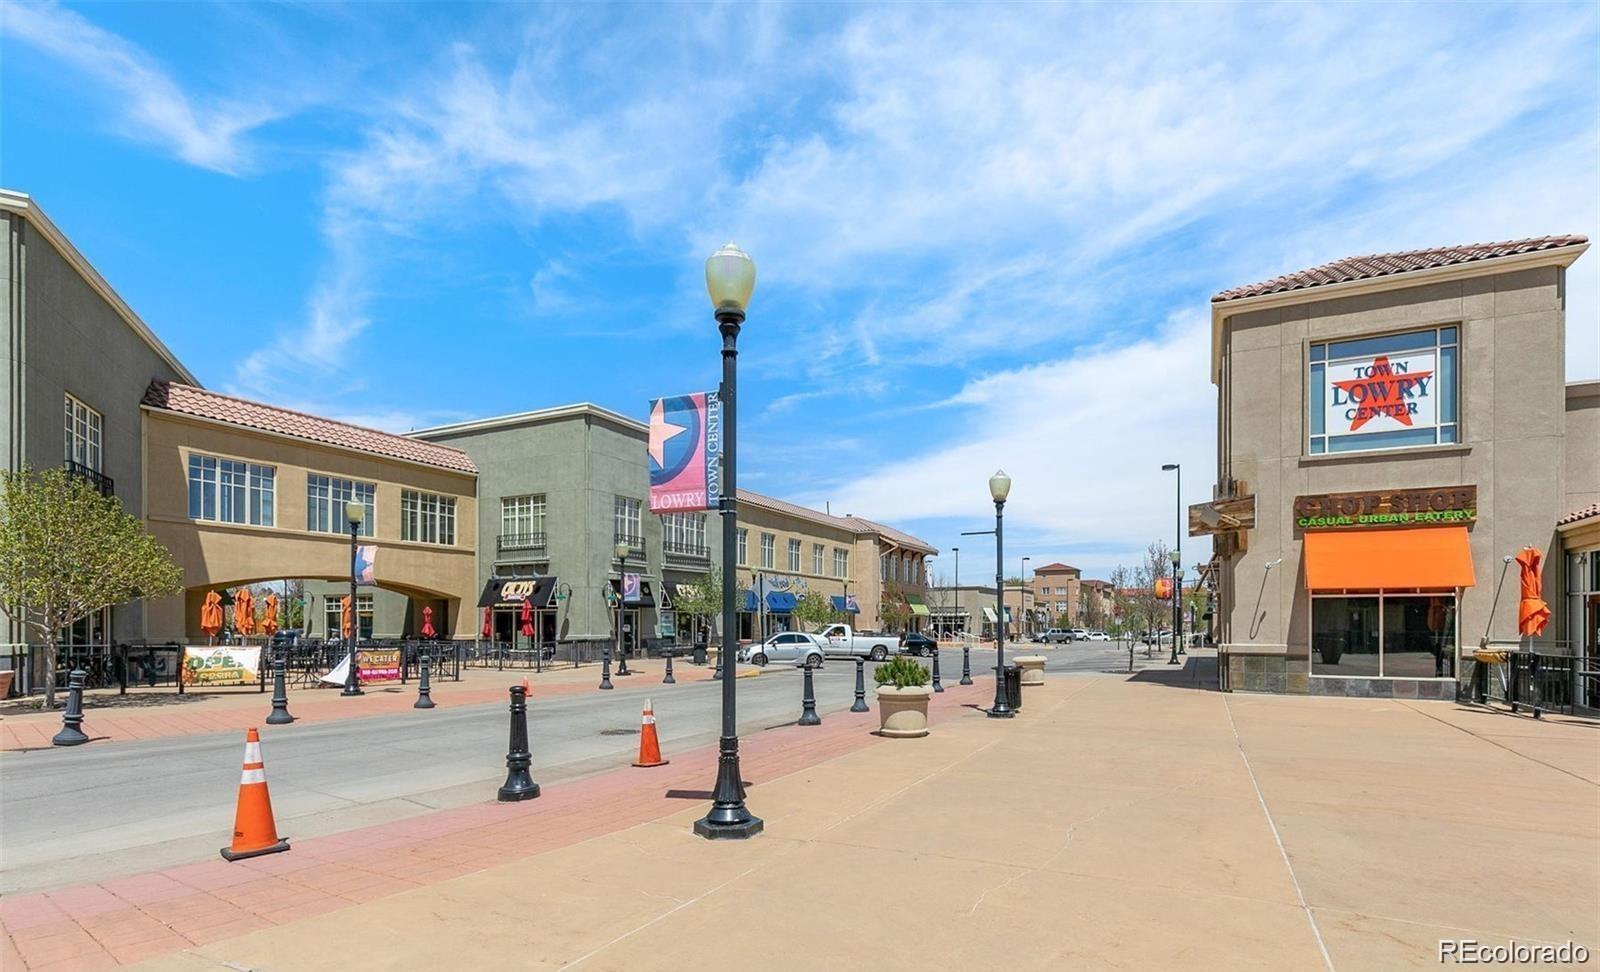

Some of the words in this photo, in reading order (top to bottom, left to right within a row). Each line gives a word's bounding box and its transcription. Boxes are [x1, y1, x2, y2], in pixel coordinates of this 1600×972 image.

[1353, 361, 1408, 379] TOWN
[1331, 375, 1432, 407] LOWRY
[707, 391, 720, 453] CENTER
[1344, 402, 1419, 421] CENTER
[707, 456, 719, 505] TOWN
[650, 491, 705, 510] LOWRY
[1299, 495, 1381, 517] CHOP
[1389, 489, 1474, 512] SHOP
[1298, 515, 1353, 527] CASUAL
[1359, 512, 1409, 524] URBAN
[1414, 509, 1474, 521] EATERY
